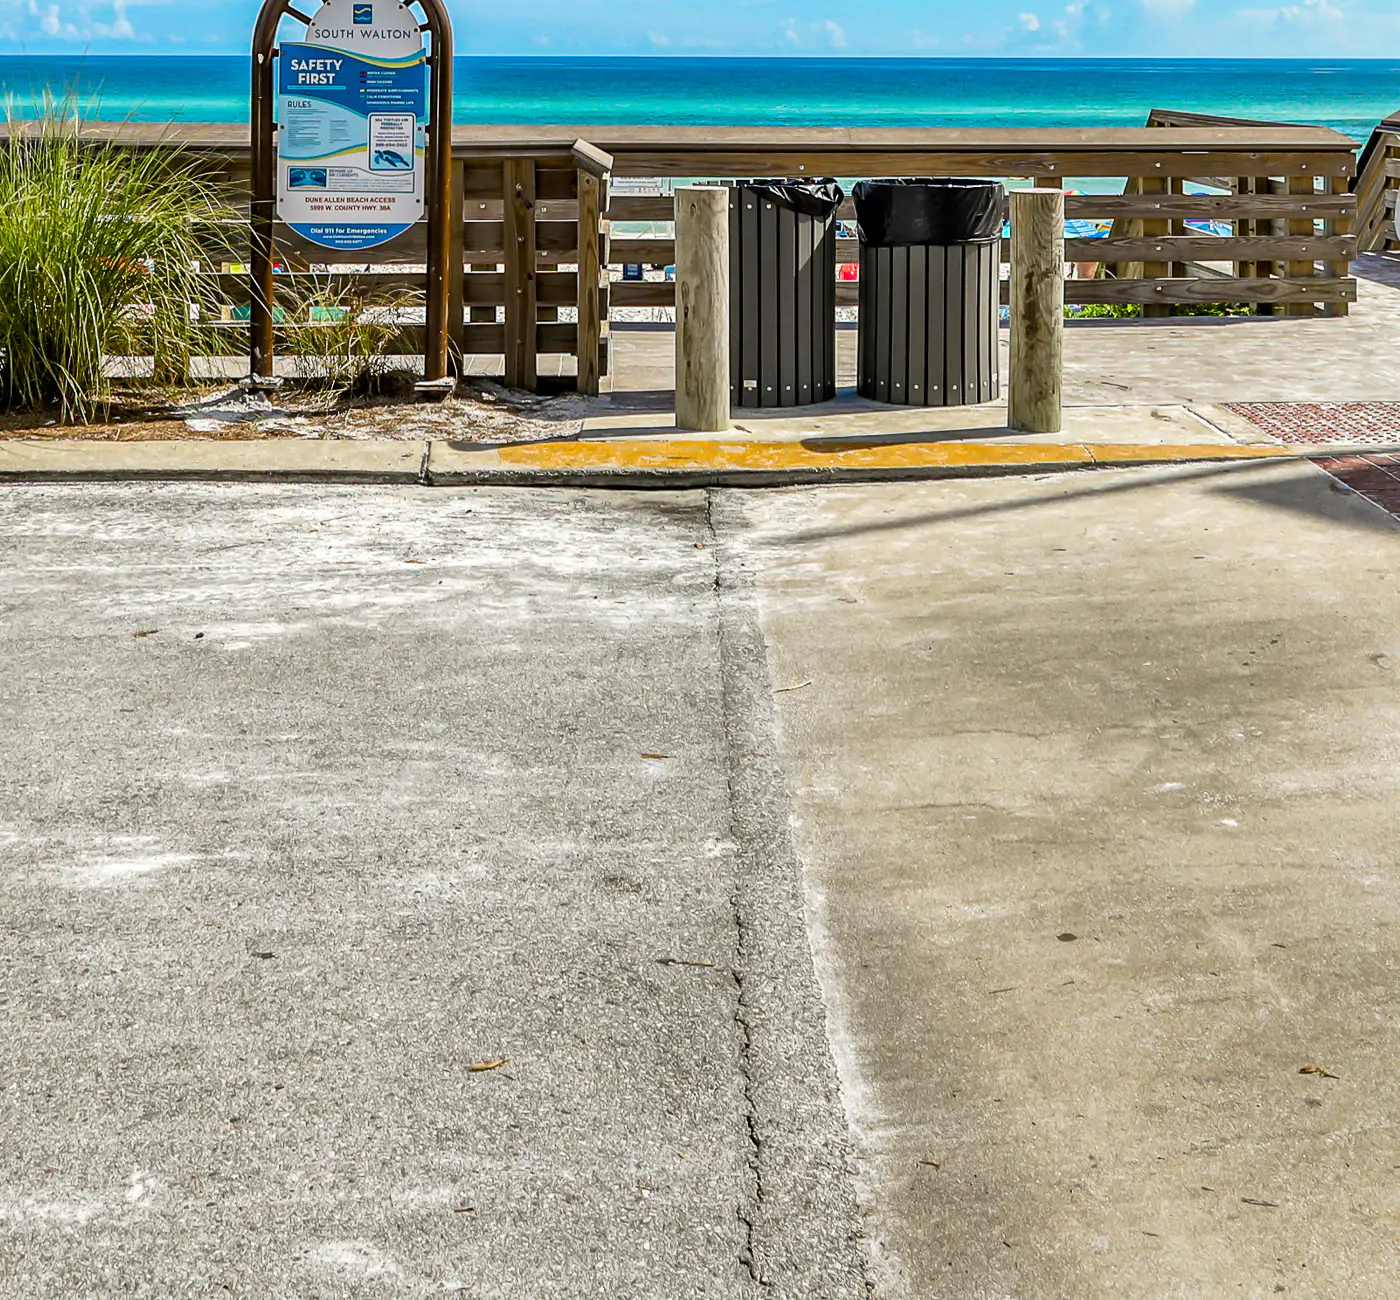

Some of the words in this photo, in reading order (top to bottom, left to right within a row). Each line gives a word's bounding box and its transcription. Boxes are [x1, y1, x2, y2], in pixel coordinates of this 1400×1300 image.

[314, 28, 354, 39] SOUTH
[360, 28, 411, 39] WALTON
[290, 59, 343, 71] SAFETY
[298, 73, 336, 85] FIRST
[287, 100, 312, 108] RULES
